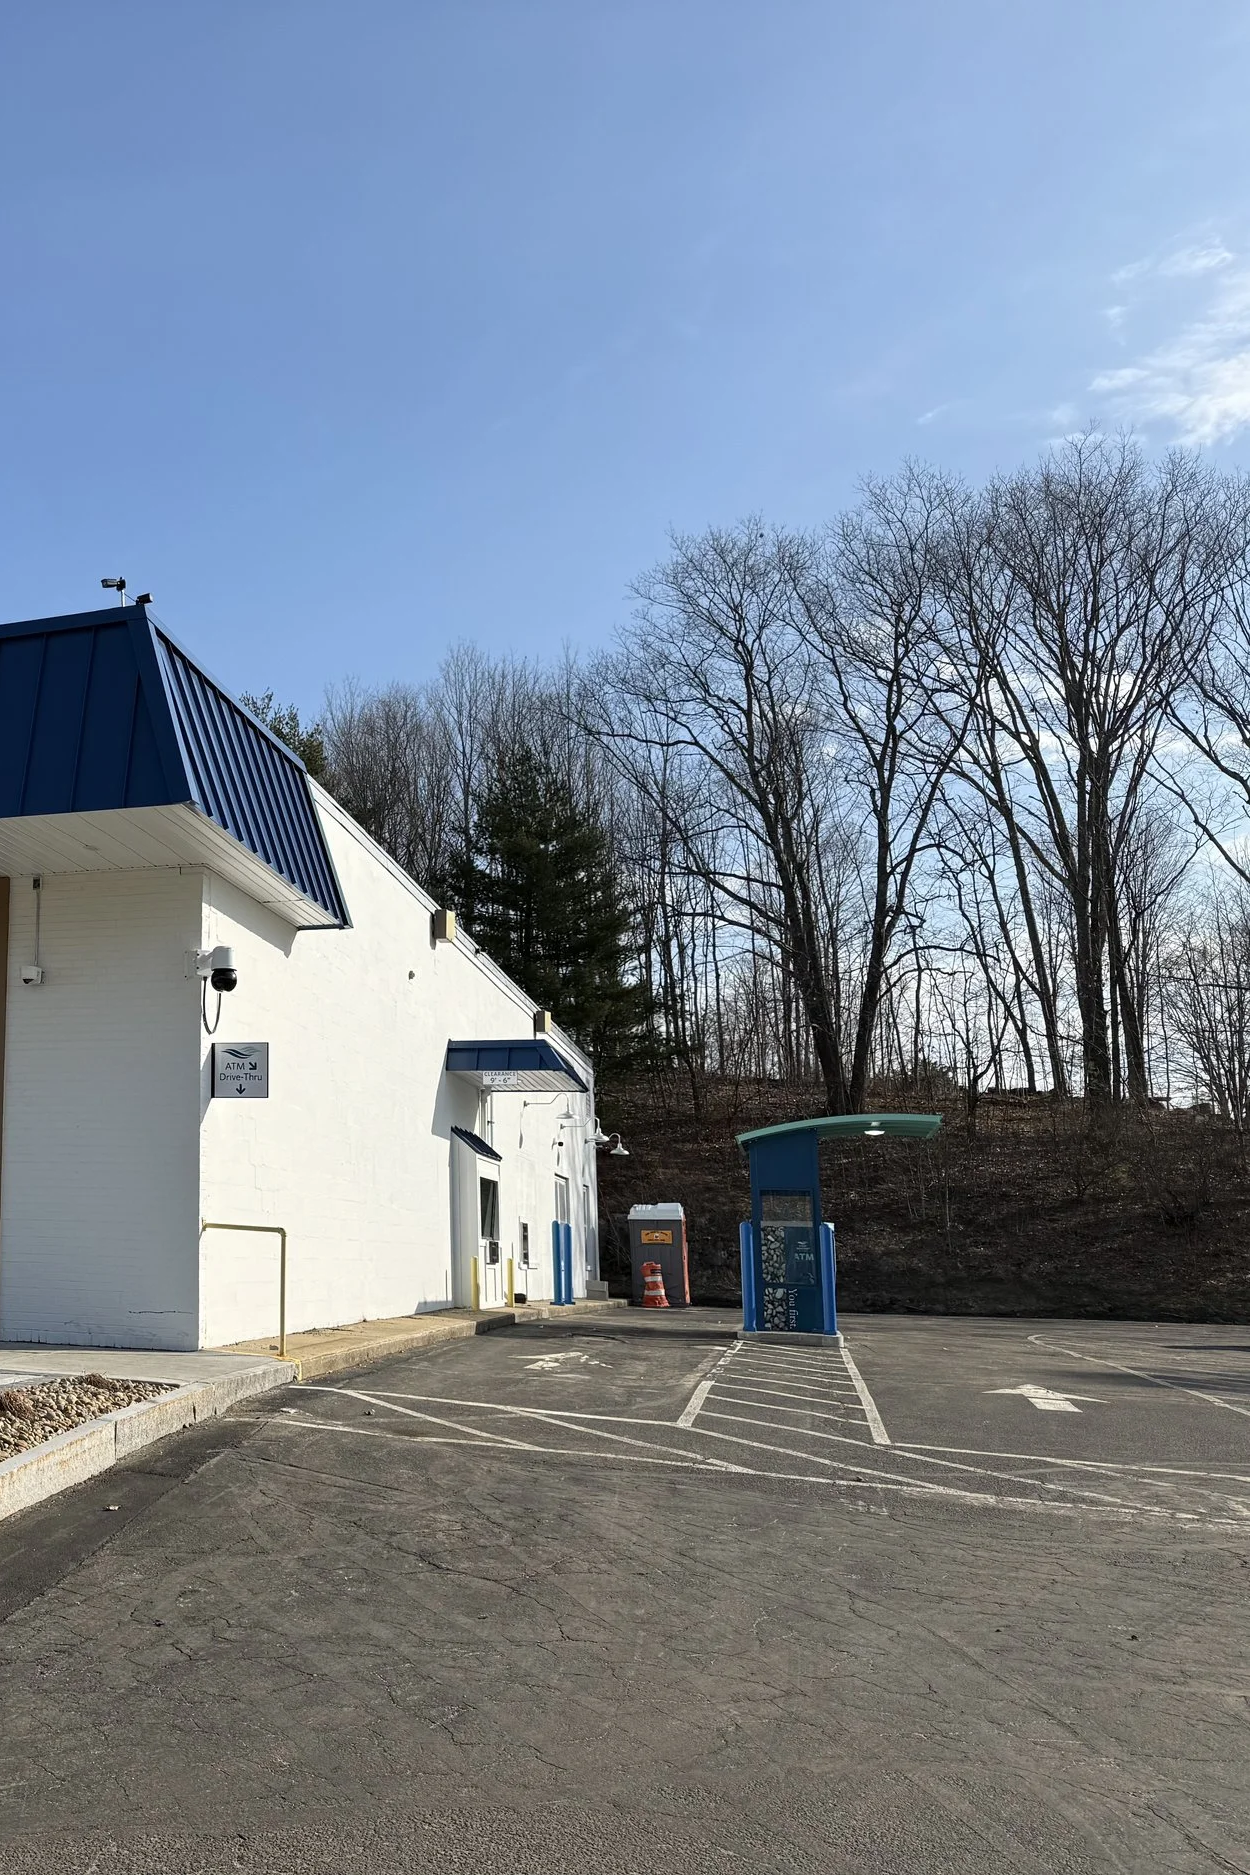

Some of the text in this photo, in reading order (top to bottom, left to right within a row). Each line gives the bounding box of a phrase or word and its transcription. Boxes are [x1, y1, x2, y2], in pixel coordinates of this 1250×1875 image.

[225, 1062, 245, 1071] ATM
[219, 1072, 263, 1081] Drive-Thru
[788, 1288, 798, 1307] You
